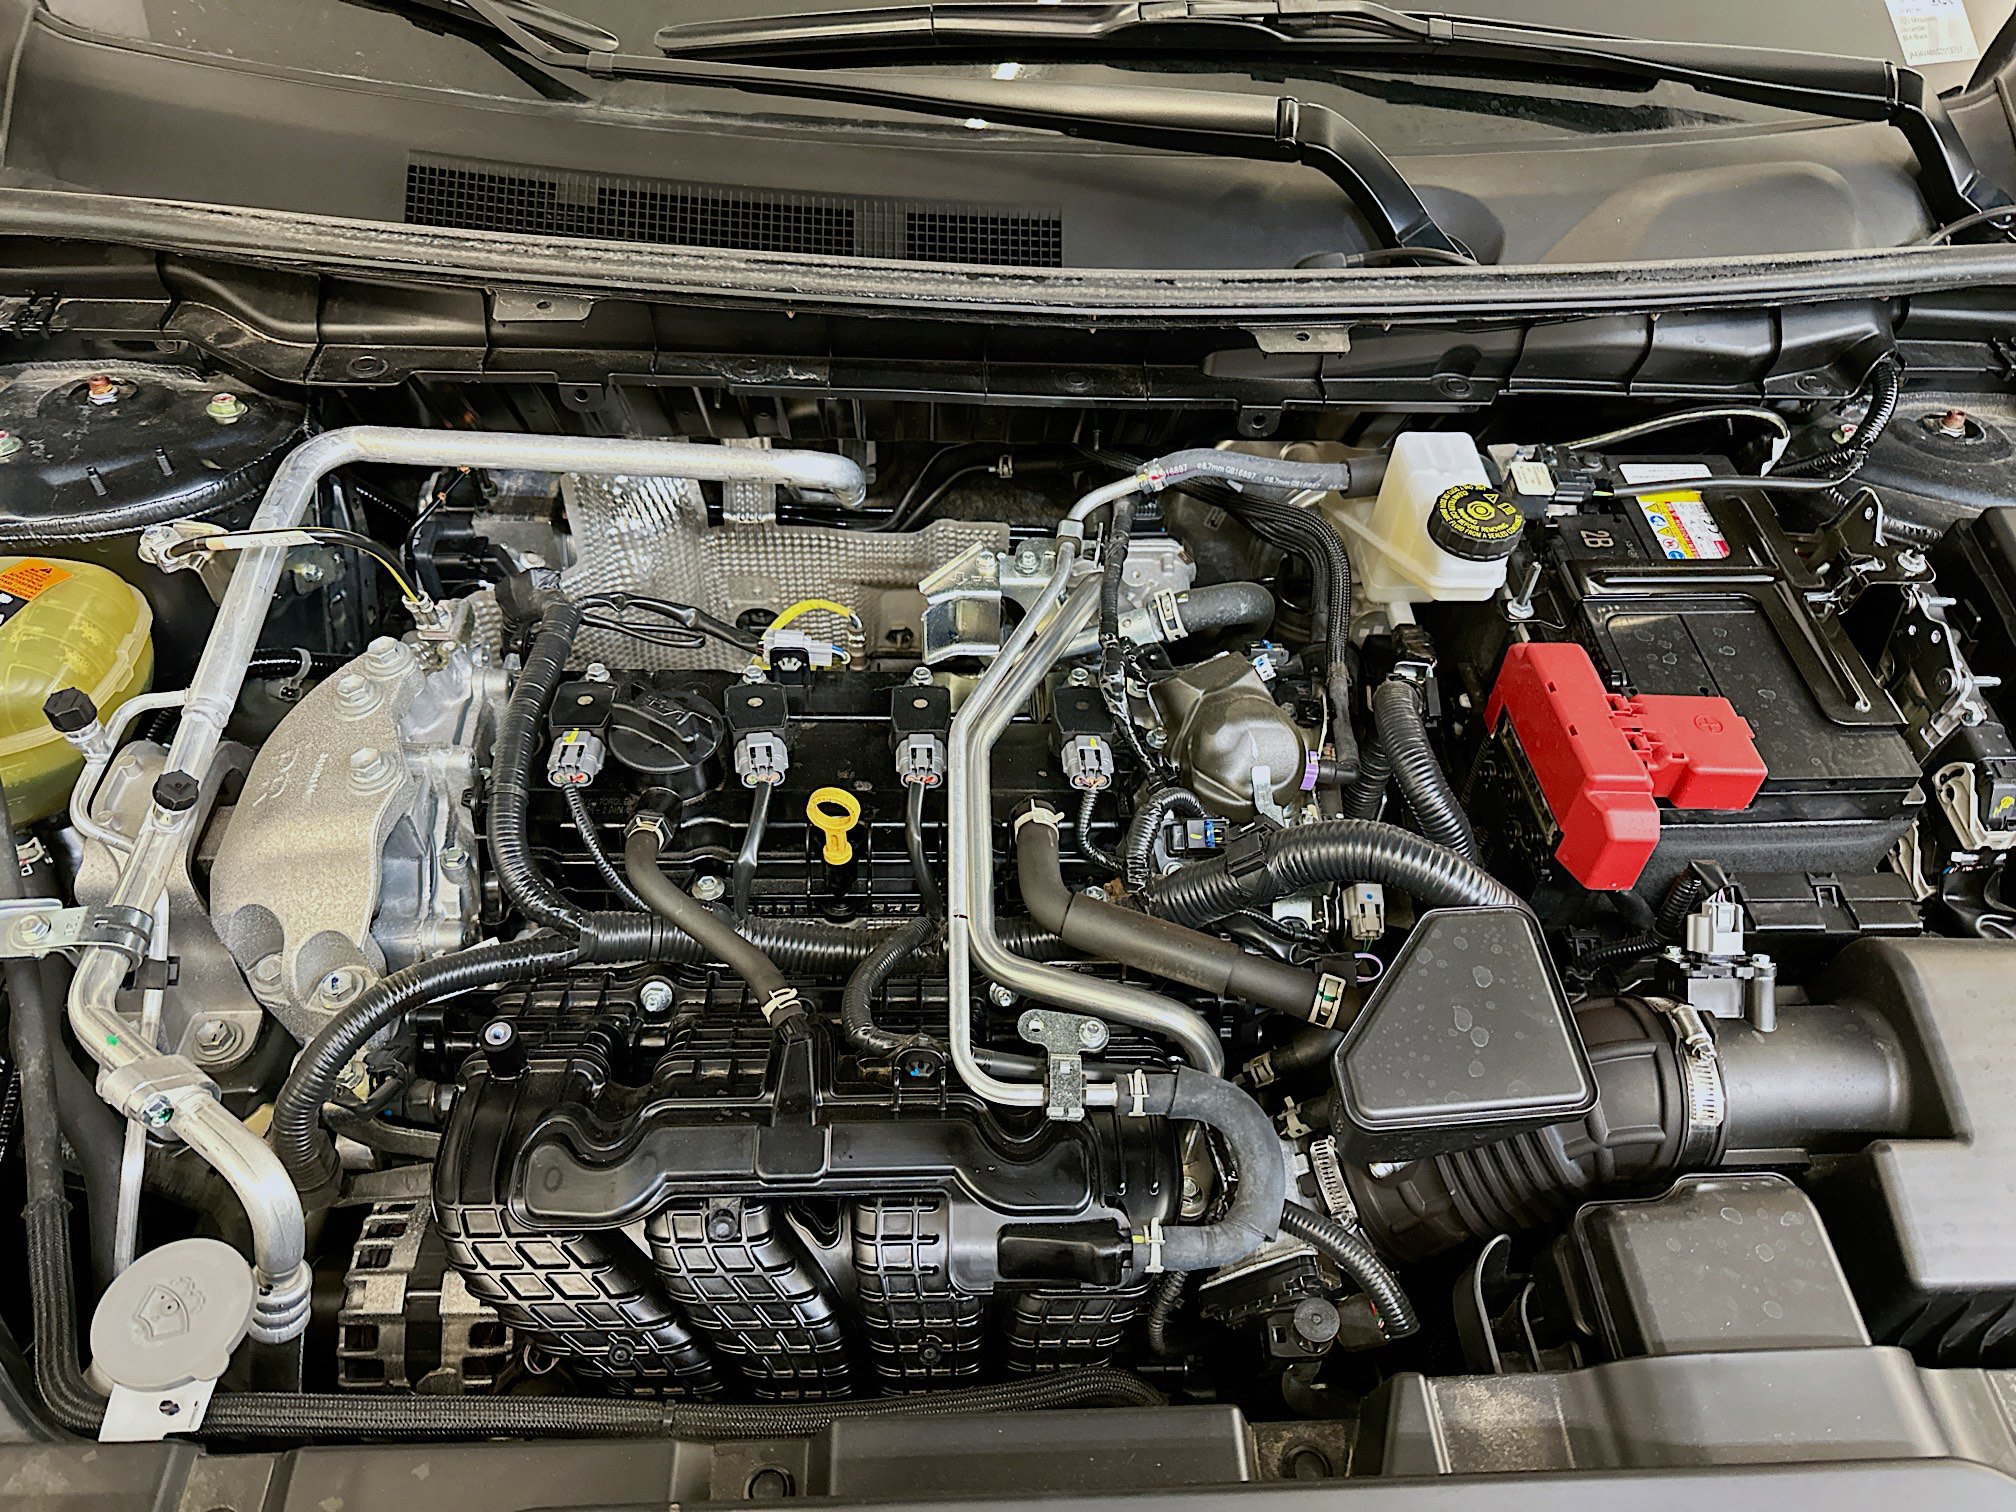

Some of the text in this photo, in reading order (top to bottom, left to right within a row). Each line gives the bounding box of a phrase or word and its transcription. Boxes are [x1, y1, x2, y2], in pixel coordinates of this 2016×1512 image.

[1164, 463, 1188, 476] 16897
[1225, 465, 1256, 479] GB16897
[1463, 527, 1481, 538] FROM
[1486, 529, 1510, 539] SEALED
[1580, 529, 1614, 548] 2B
